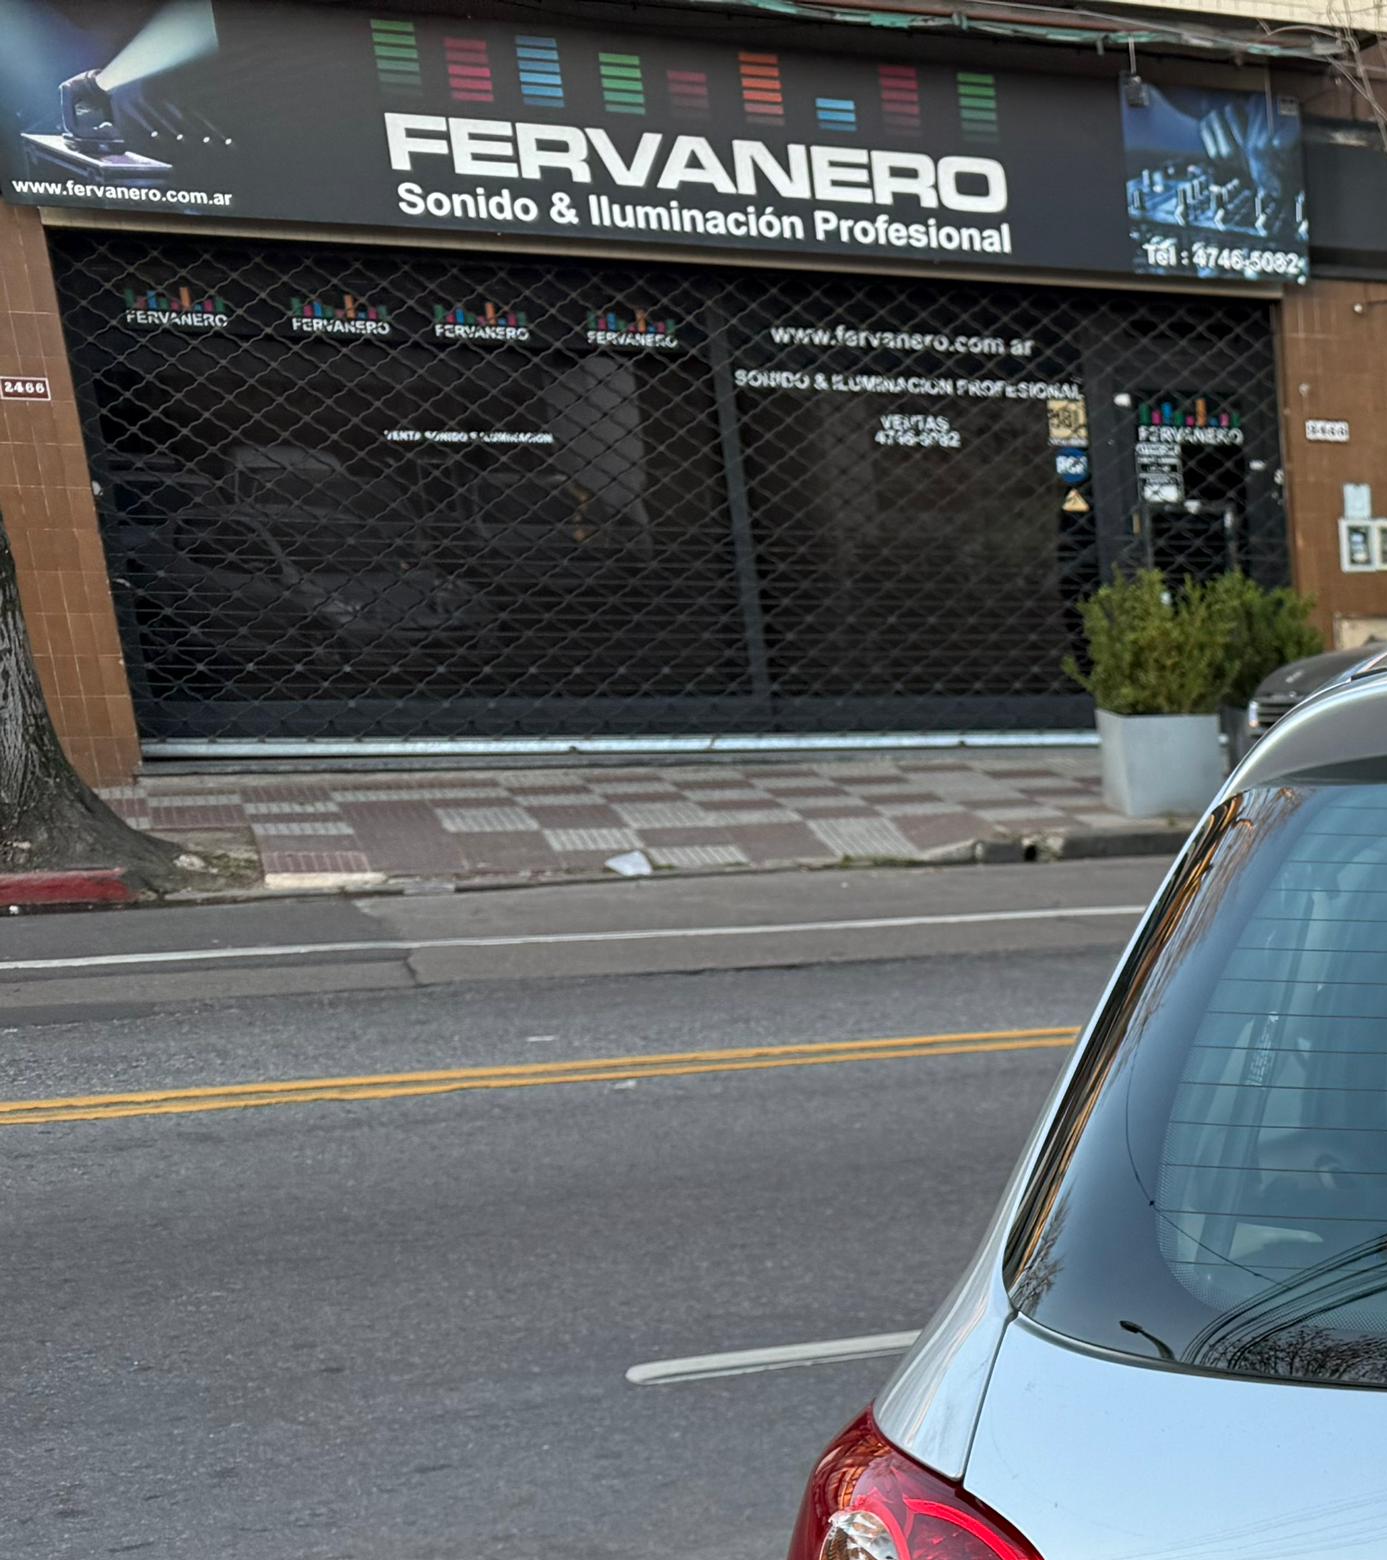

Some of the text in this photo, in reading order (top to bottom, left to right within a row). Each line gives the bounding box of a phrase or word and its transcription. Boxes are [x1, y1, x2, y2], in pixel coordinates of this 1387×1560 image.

[384, 113, 1009, 213] FERVANERO
[12, 180, 232, 206] www.fervanero.com.ar
[398, 182, 1012, 255] Sonido & Iluminación Profesional
[126, 310, 227, 328] FERVANERO
[292, 317, 391, 335] FERVANERO
[434, 323, 530, 341] FERVANERO
[4, 381, 45, 394] 2466
